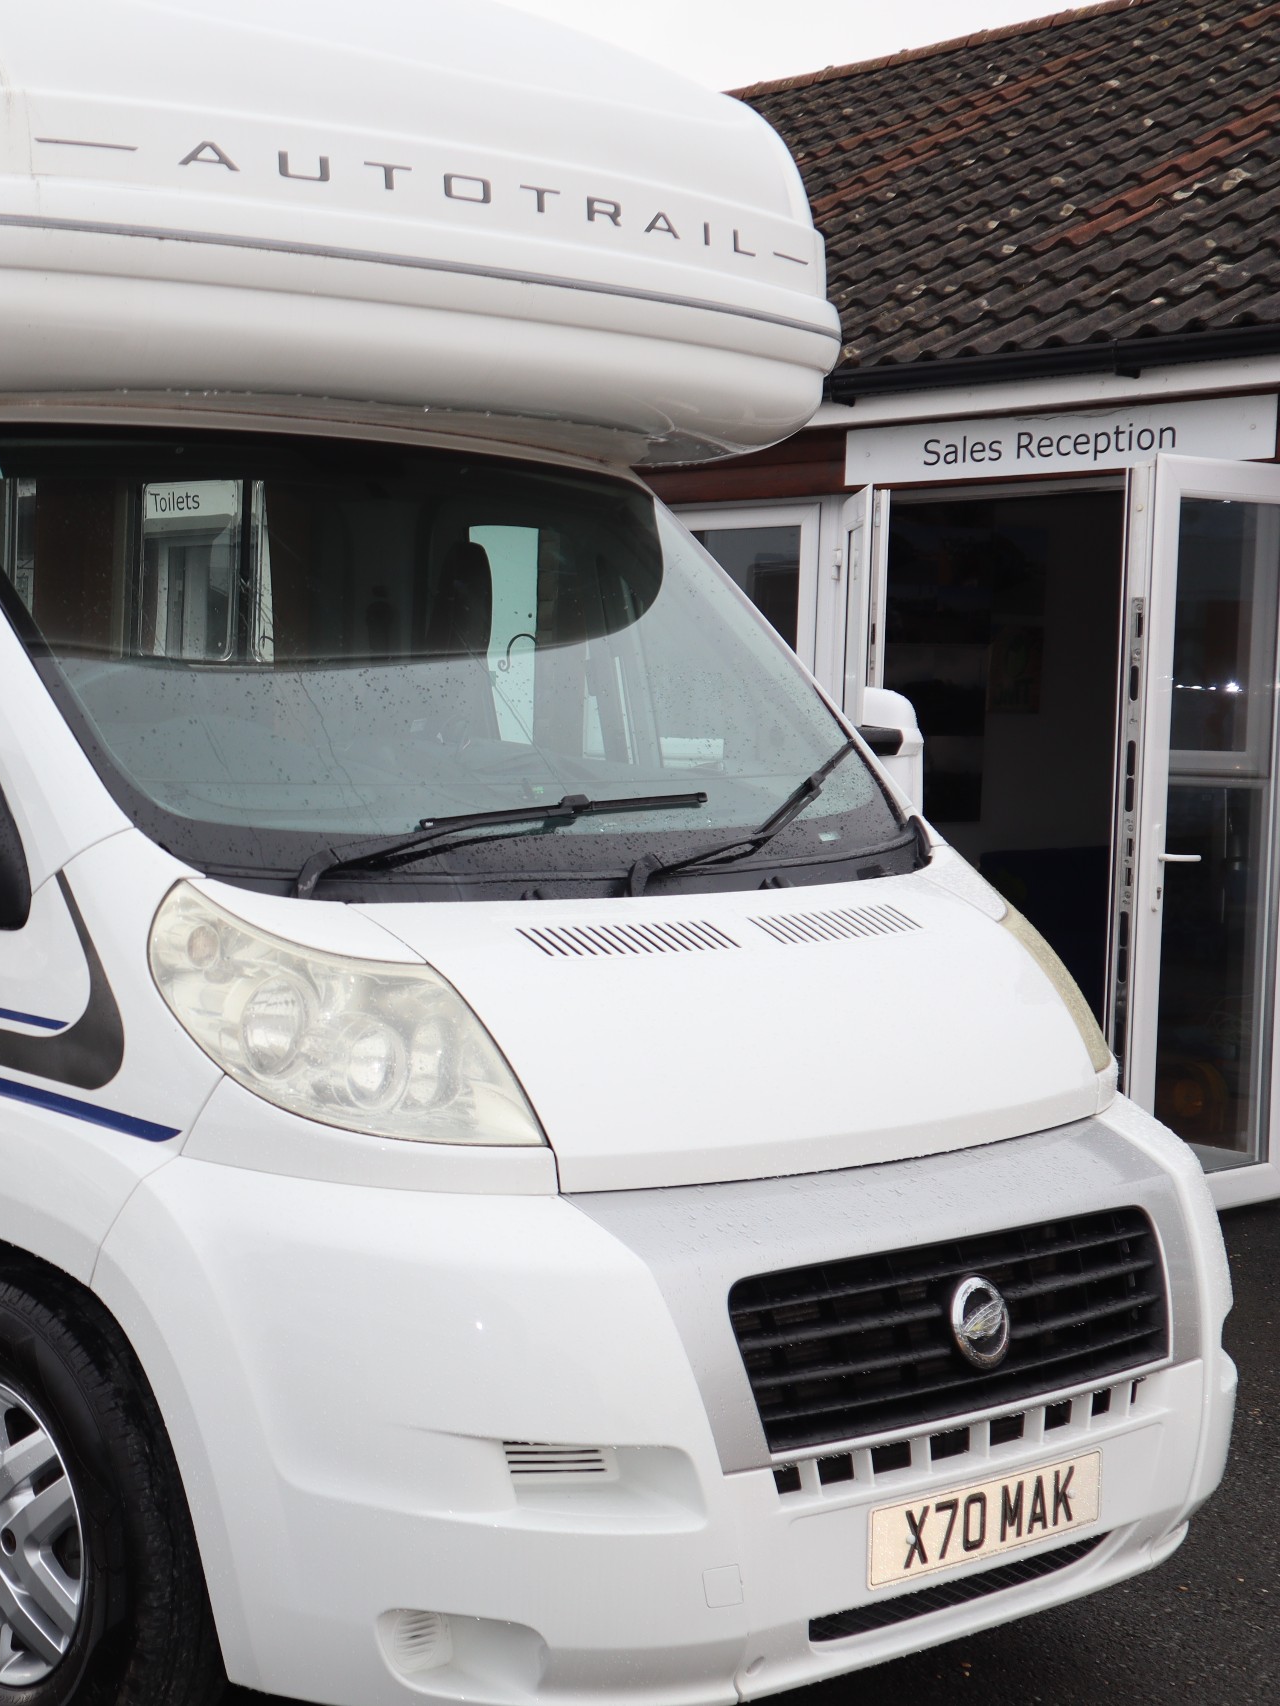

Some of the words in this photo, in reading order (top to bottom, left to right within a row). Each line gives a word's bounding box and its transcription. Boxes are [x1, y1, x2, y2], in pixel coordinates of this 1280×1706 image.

[178, 140, 756, 257] AUTOTRAIL
[923, 436, 1003, 466] Sales
[1016, 423, 1177, 461] Reception
[150, 491, 200, 512] Toilets
[903, 1491, 987, 1569] X70
[999, 1465, 1075, 1542] MAK
